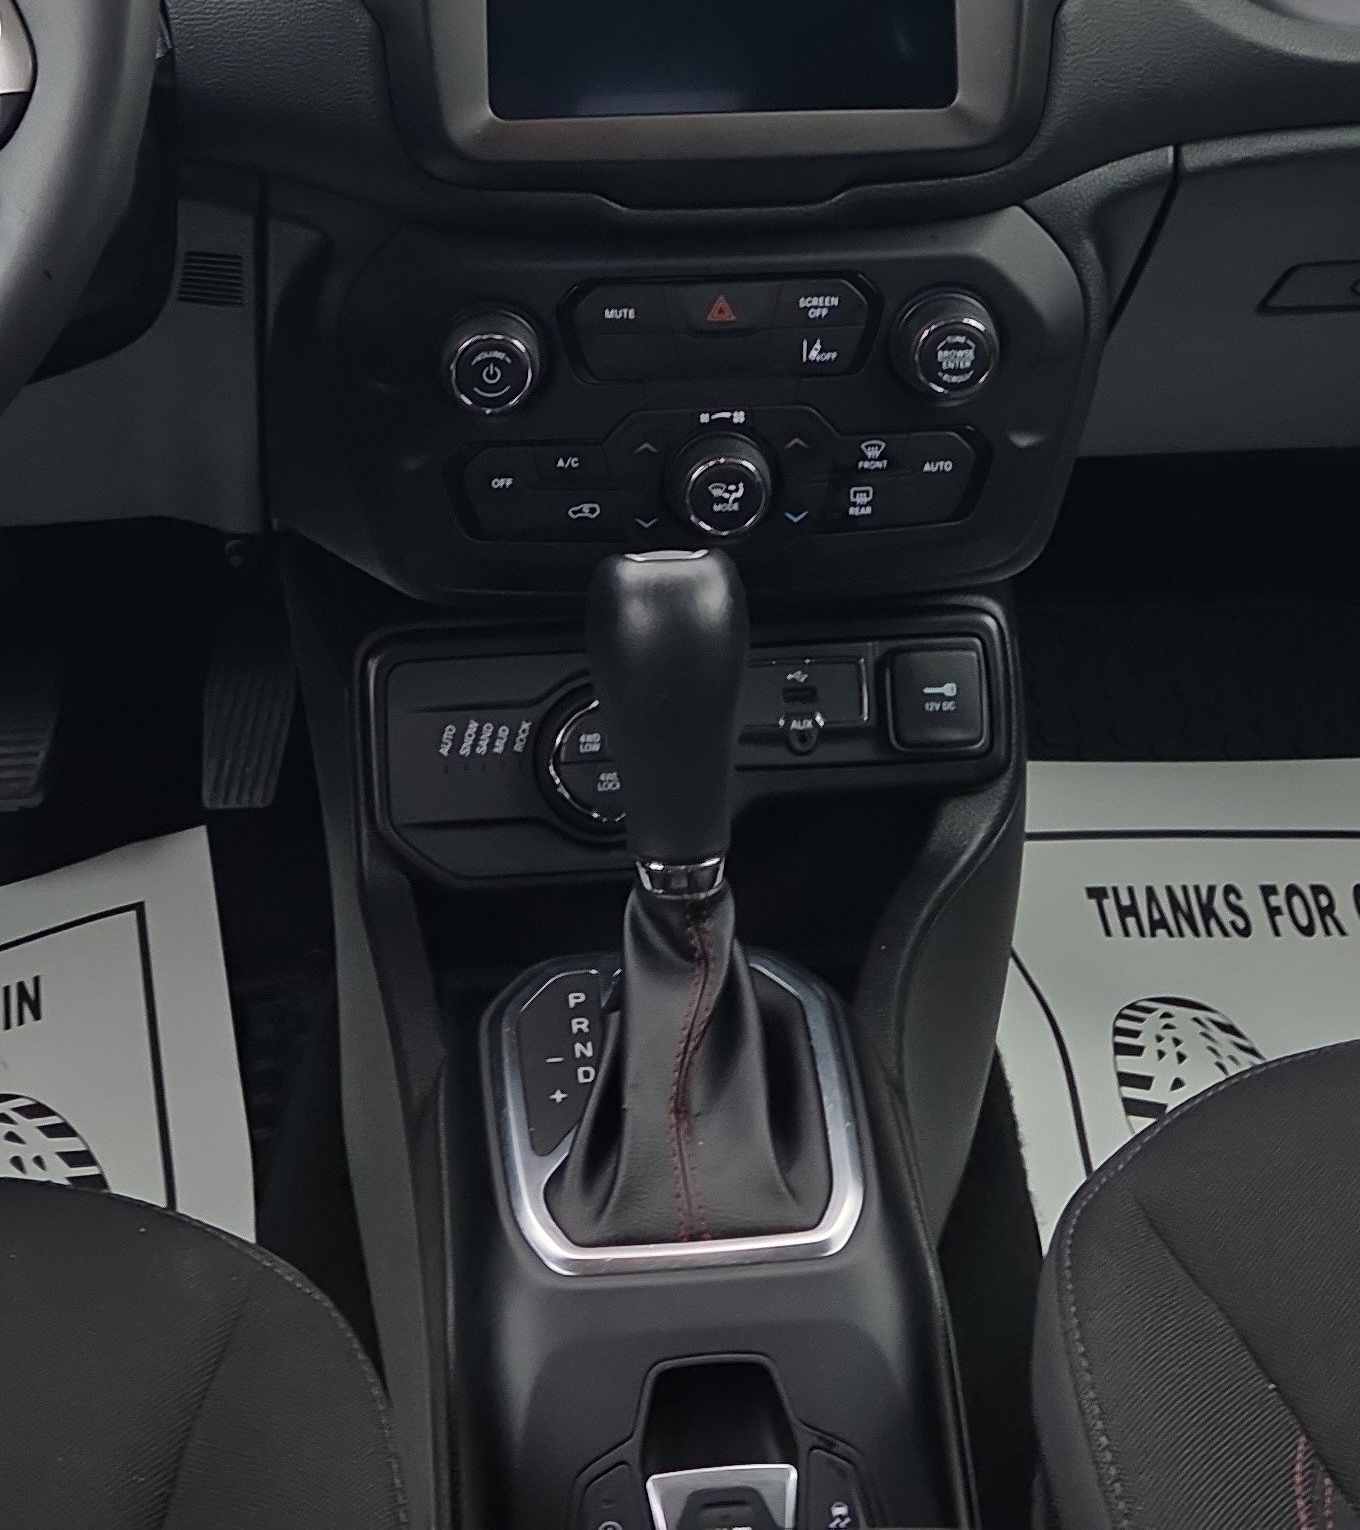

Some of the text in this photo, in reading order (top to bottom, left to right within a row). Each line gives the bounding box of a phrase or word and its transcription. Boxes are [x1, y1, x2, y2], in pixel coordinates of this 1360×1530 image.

[798, 296, 839, 308] SCREEN
[604, 307, 636, 320] MUTE
[807, 308, 828, 319] OFF
[820, 350, 838, 362] OFF
[556, 456, 580, 468] A/C
[857, 459, 888, 470] FRONT
[923, 460, 953, 472] AUTO
[491, 477, 513, 489] OFF
[790, 719, 813, 730] AUX
[439, 724, 457, 757] AUTO
[459, 719, 480, 757] SNOW
[475, 722, 494, 756] SAND
[1085, 883, 1253, 939] THANKS
[1258, 881, 1348, 938] FOR
[1, 975, 43, 1031] IN
[568, 992, 586, 1009] P
[571, 1017, 590, 1034] R
[574, 1040, 593, 1058] N
[577, 1065, 595, 1083] D
